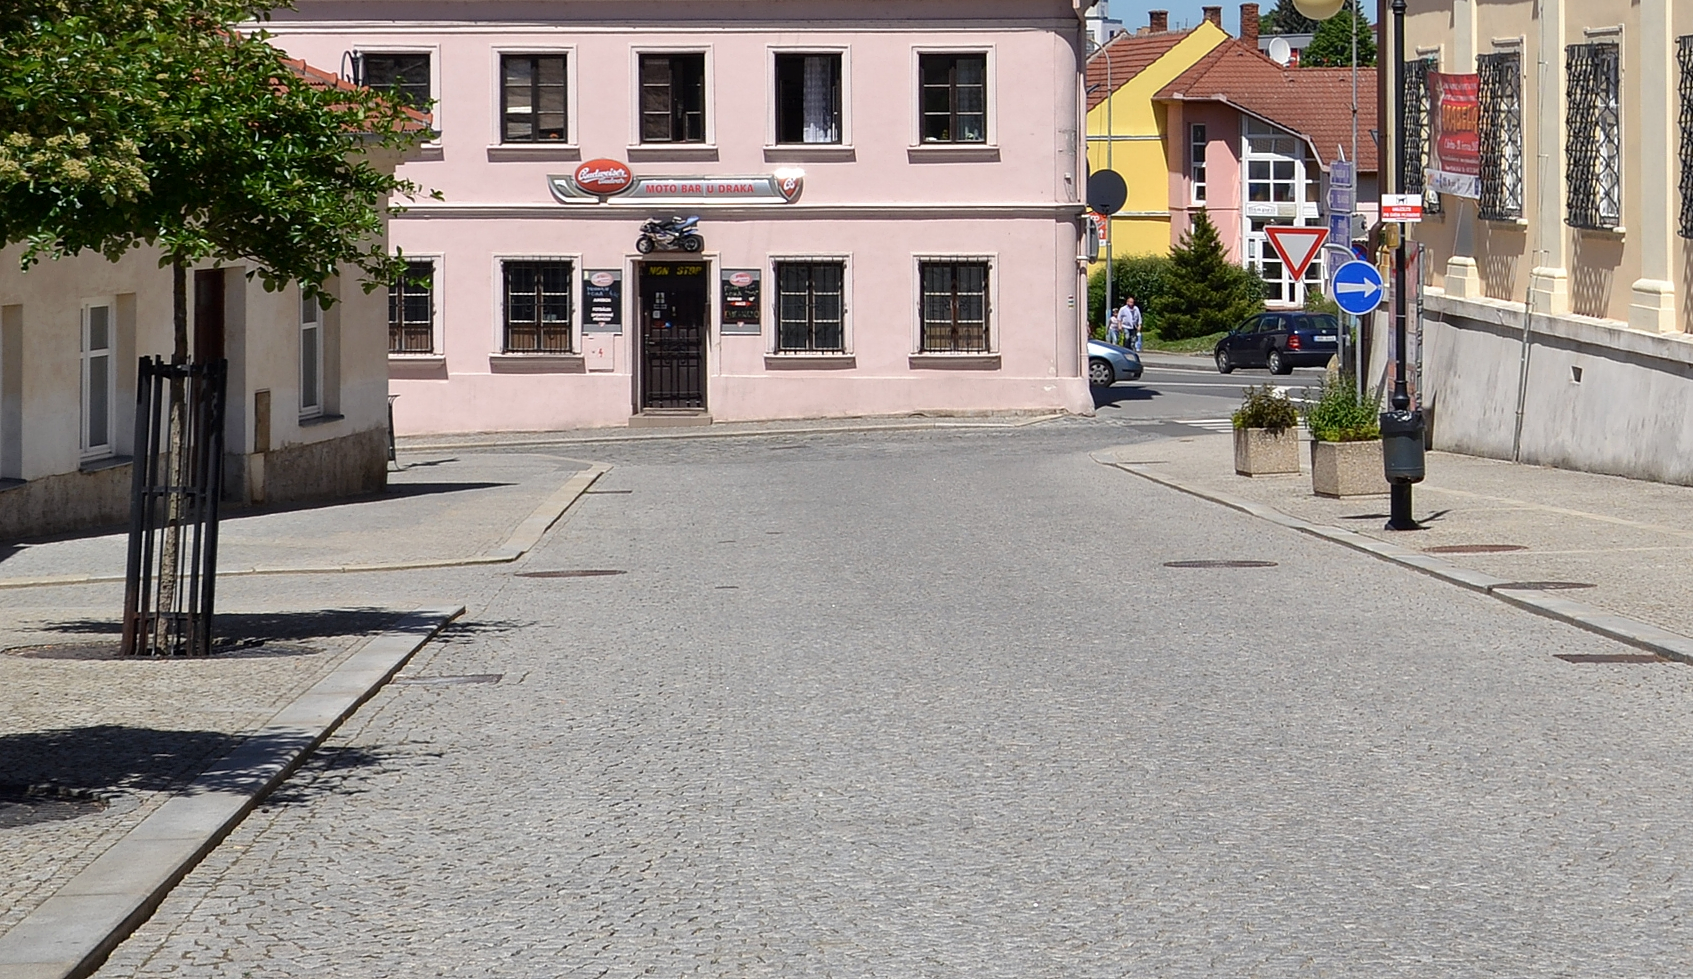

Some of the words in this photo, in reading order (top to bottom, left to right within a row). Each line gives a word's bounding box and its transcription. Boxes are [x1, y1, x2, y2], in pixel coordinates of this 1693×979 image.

[578, 167, 628, 183] Budweiser
[645, 184, 677, 194] MOTO
[681, 184, 702, 194] BAR
[706, 184, 714, 194] U
[718, 184, 754, 194] DRAKA
[650, 266, 670, 275] NON
[676, 266, 702, 275] STOP
